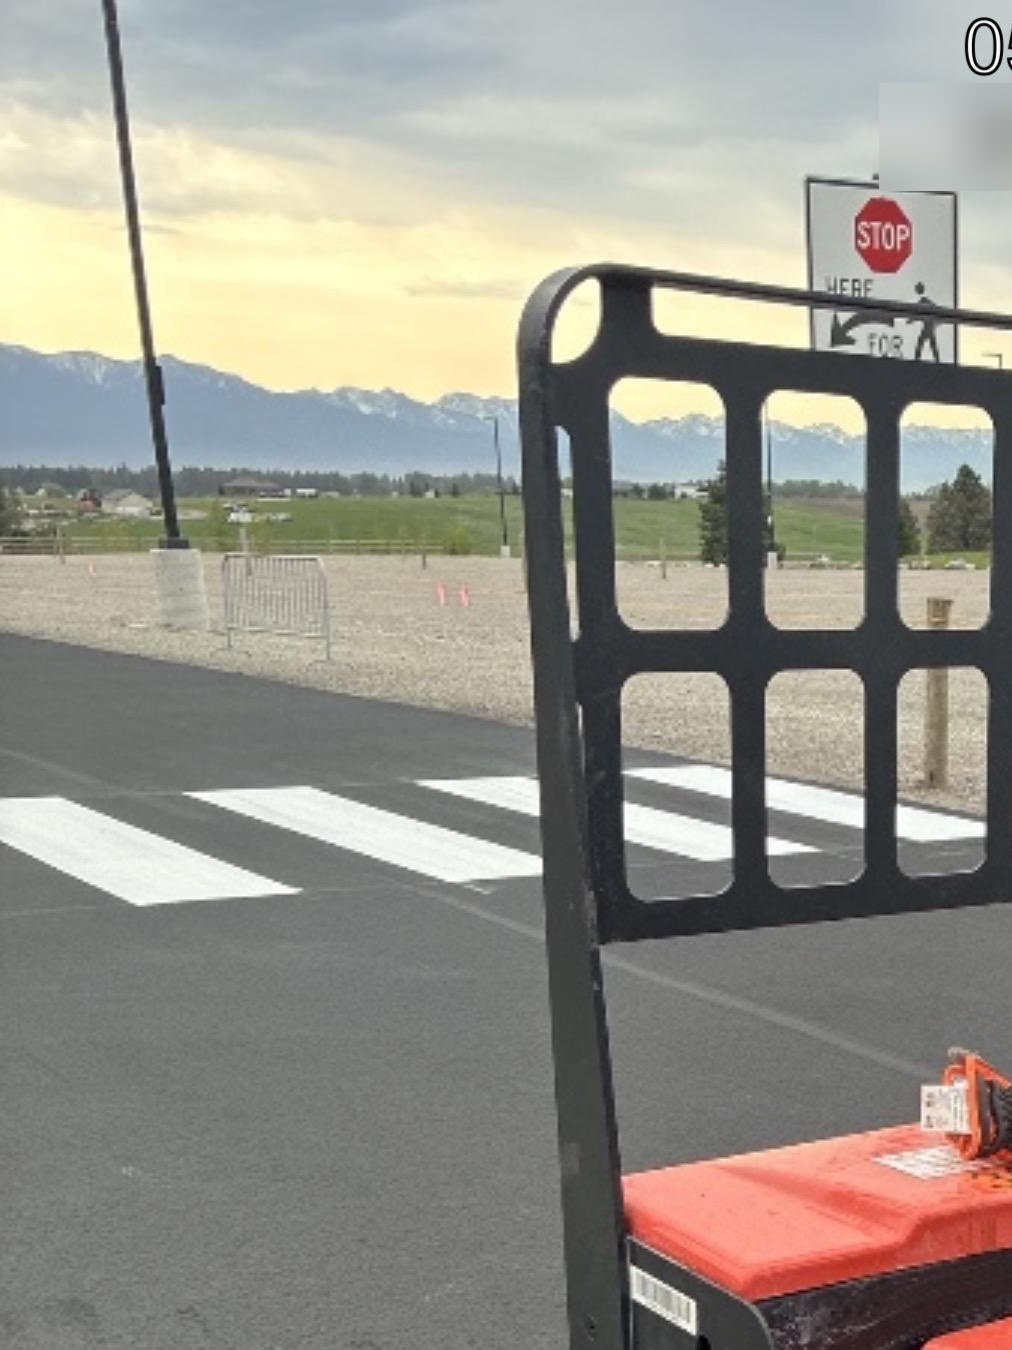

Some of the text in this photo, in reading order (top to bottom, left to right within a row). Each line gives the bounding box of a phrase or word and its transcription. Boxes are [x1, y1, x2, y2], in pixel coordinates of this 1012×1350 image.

[857, 221, 910, 251] STOP
[826, 276, 873, 298] HERE
[867, 332, 904, 358] FOR
